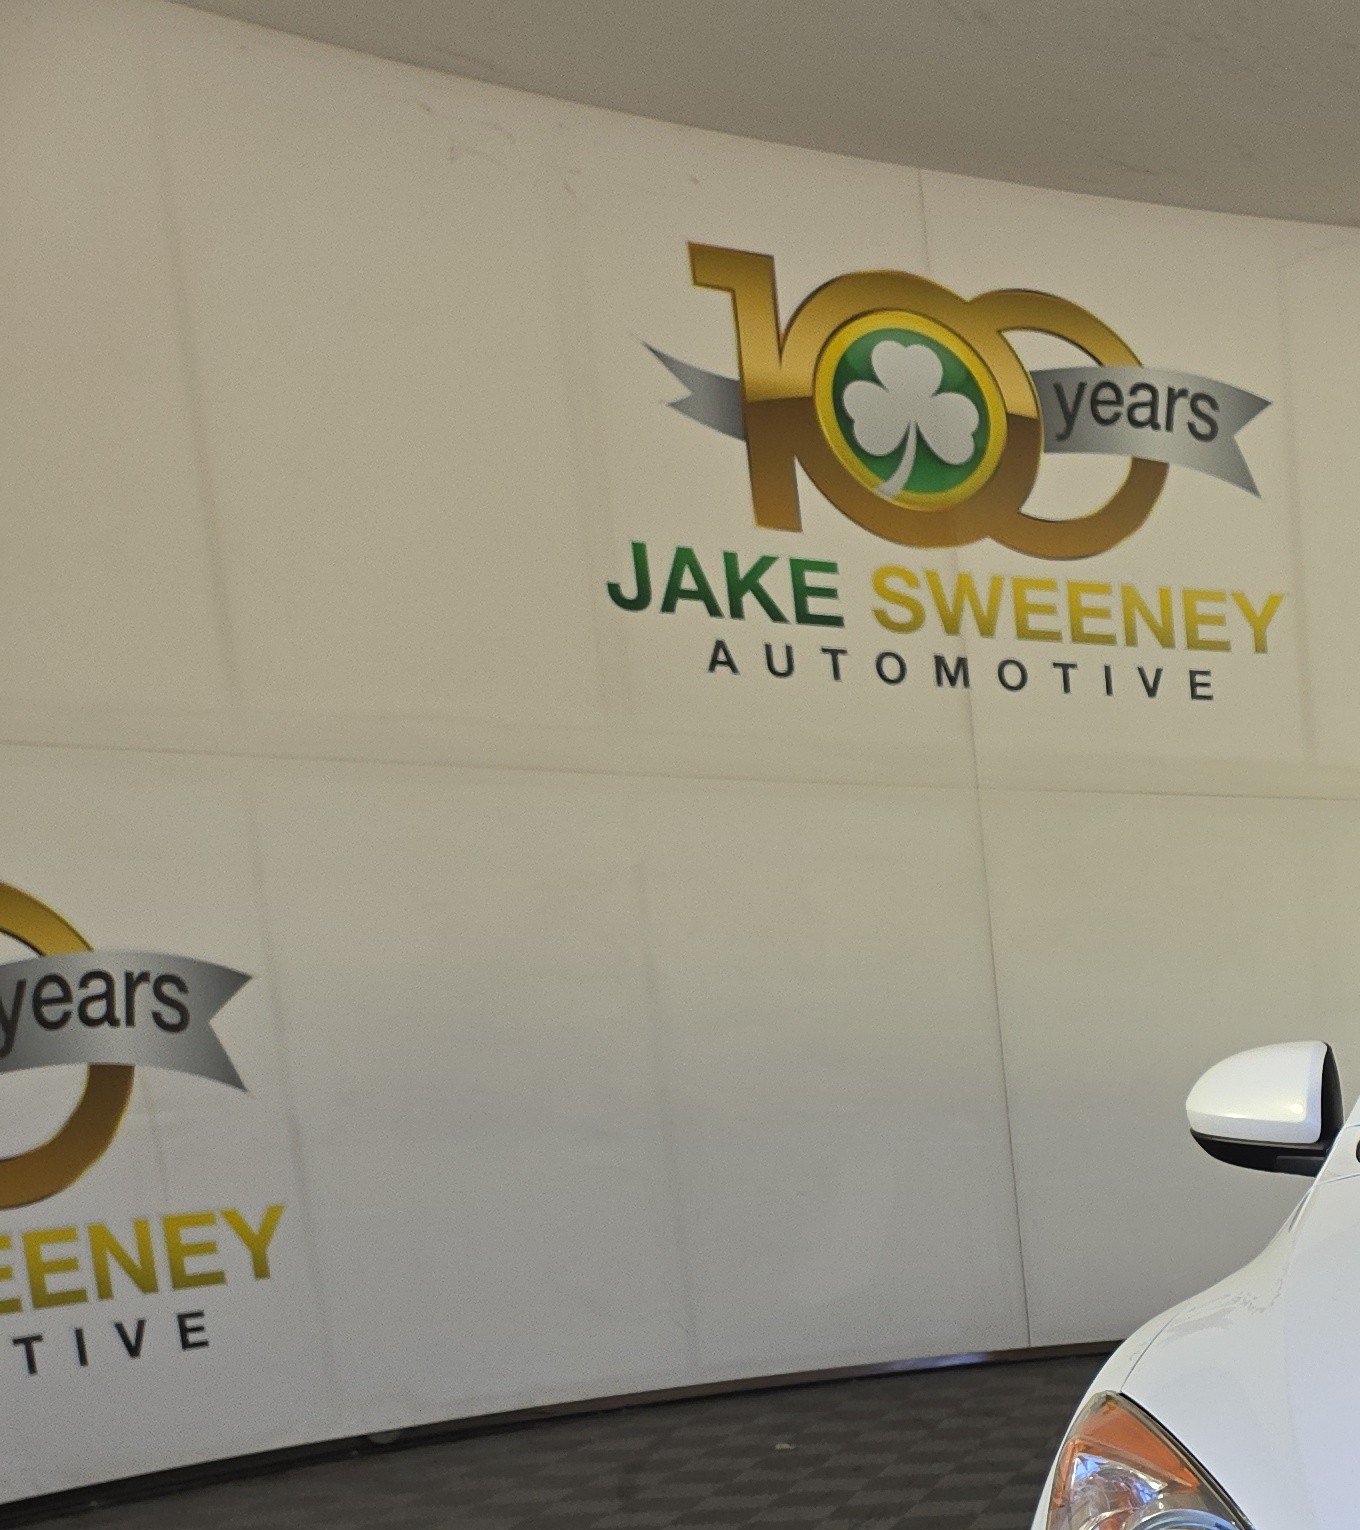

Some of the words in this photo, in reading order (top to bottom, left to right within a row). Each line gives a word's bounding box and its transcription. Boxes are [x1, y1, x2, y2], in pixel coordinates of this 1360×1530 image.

[687, 241, 1169, 561] 100
[1052, 378, 1221, 443] years
[606, 540, 845, 629] JAKE
[871, 564, 1286, 655] SWEENEY
[707, 638, 1215, 701] AUTOMOTIVE
